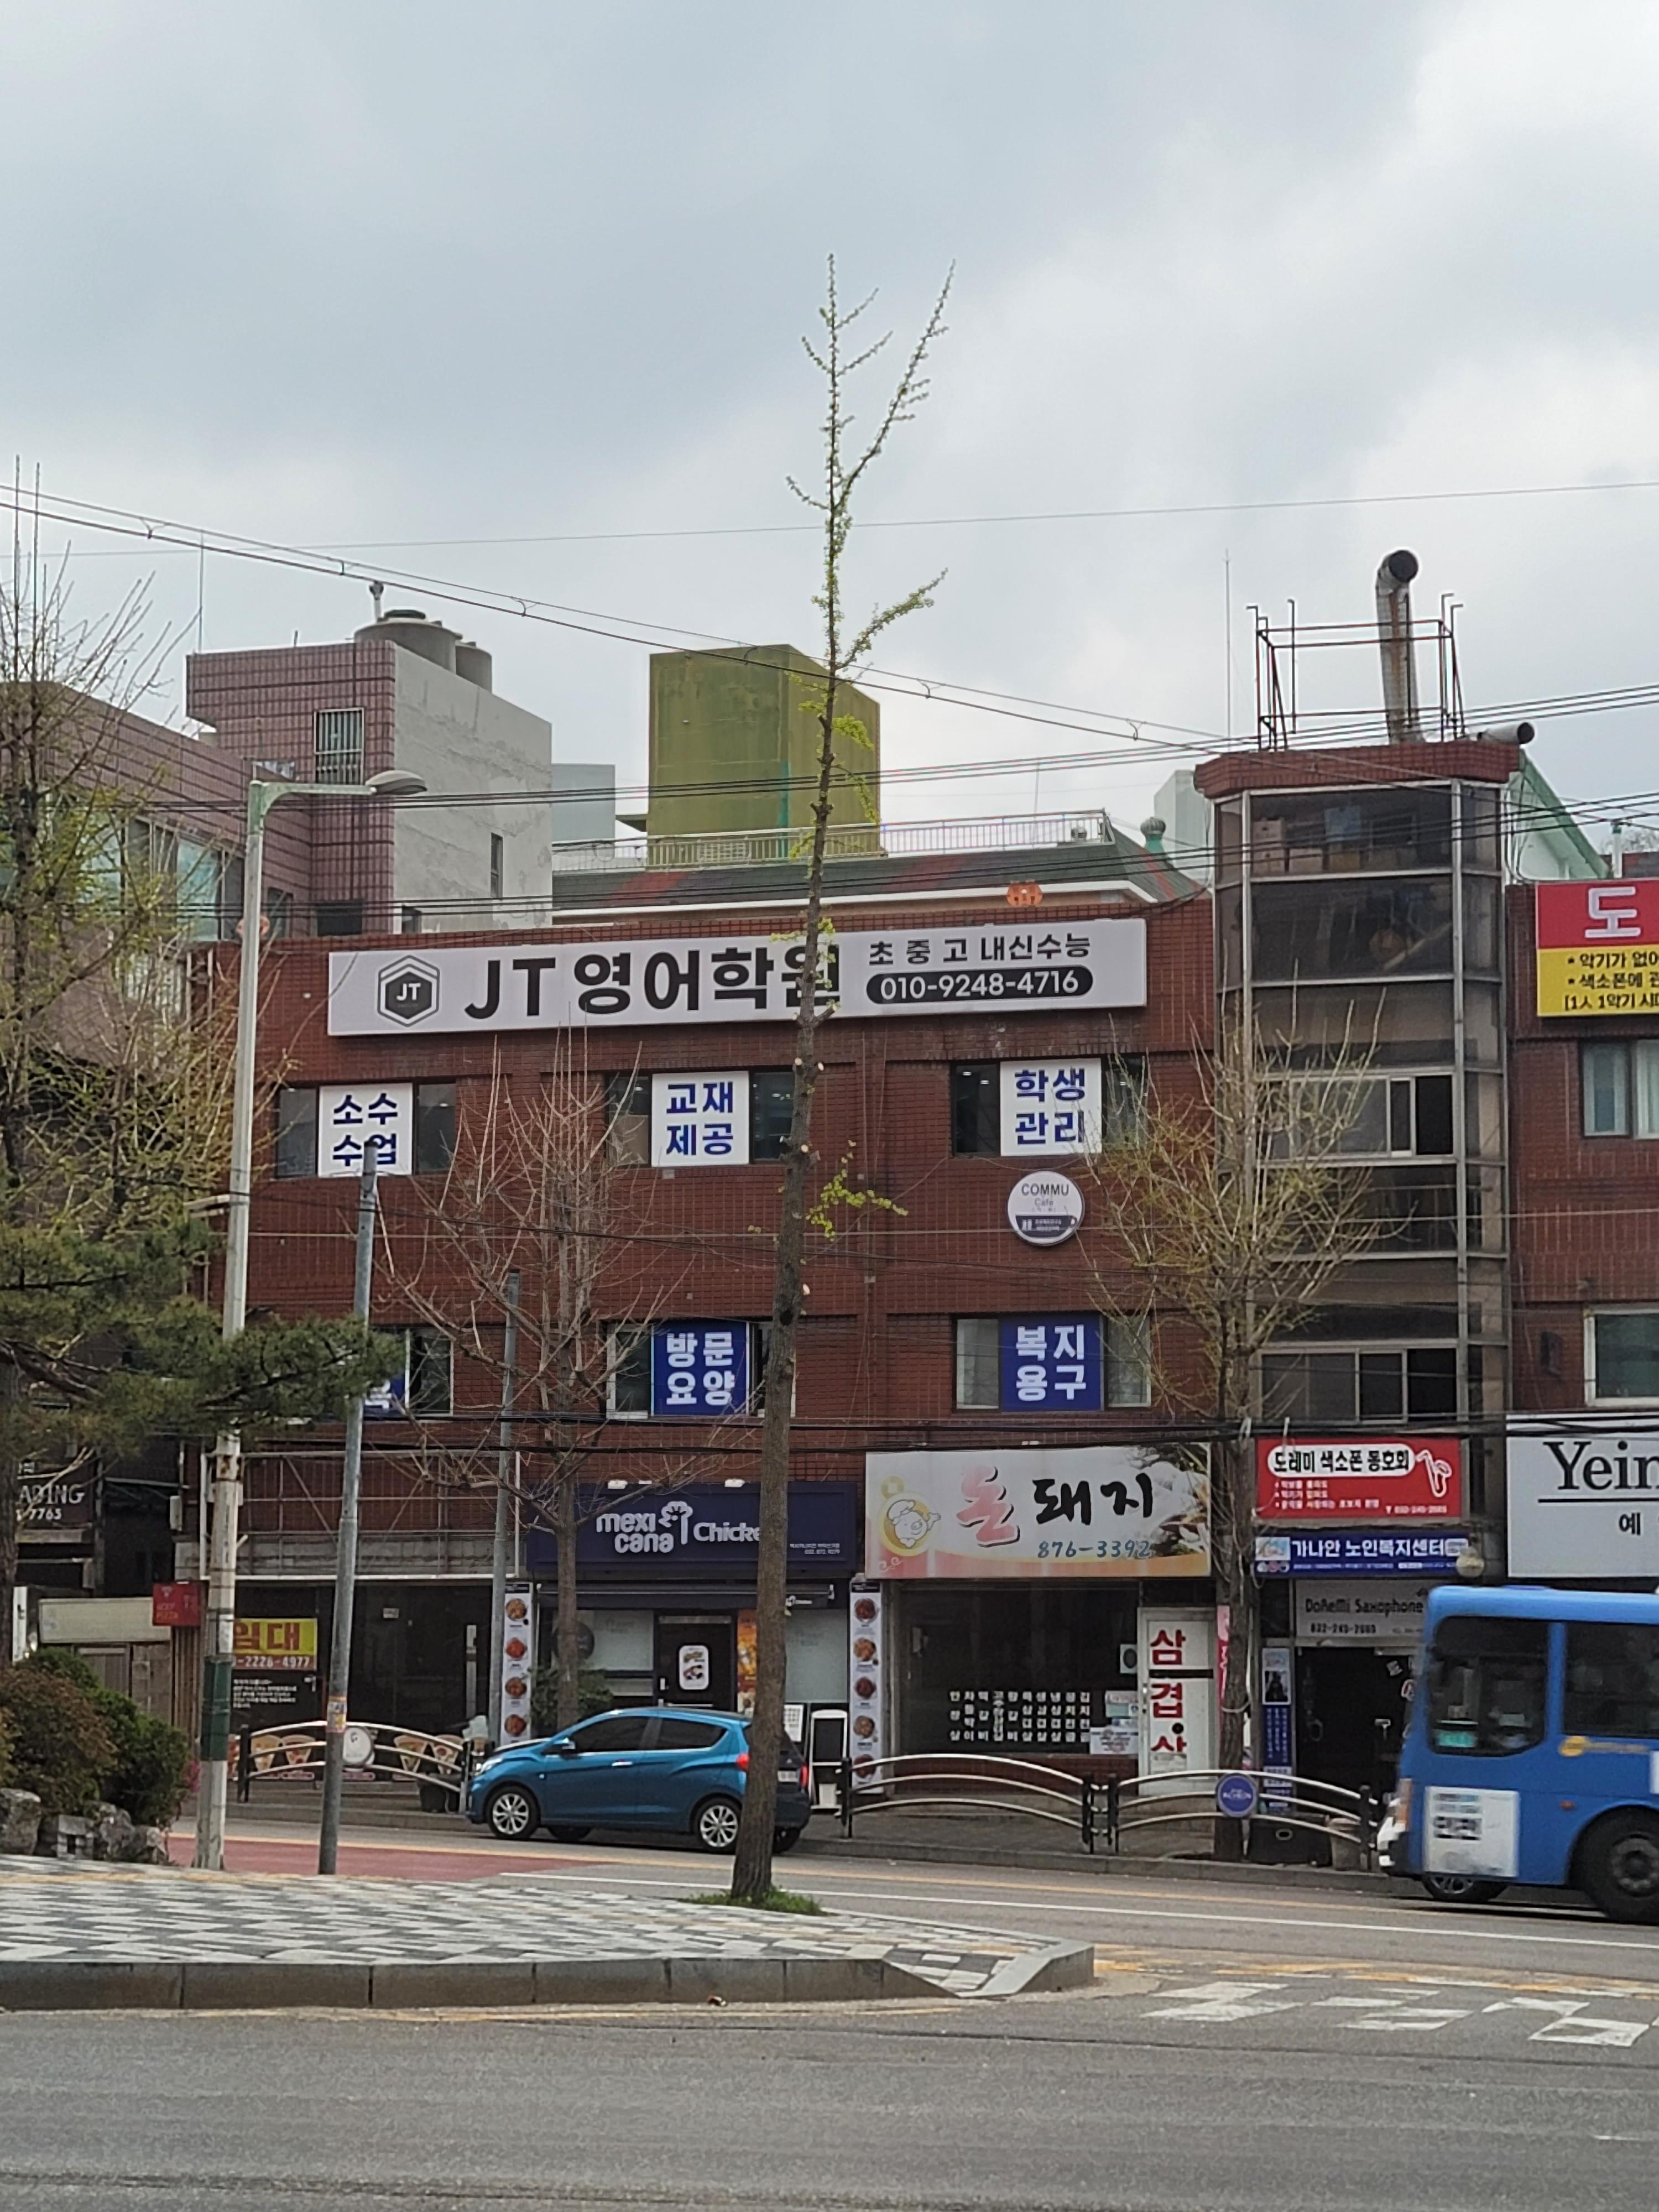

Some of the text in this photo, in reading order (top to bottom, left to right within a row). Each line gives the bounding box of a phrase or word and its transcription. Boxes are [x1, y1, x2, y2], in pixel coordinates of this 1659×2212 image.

[1585, 886, 1641, 938] 도
[869, 933, 1090, 965] 초 중 고 내신수능
[1580, 952, 1626, 968] 악기가
[396, 983, 421, 1001] JT
[880, 970, 1078, 1000] 010-9248-4716
[1639, 993, 1659, 1007] 시
[666, 1081, 733, 1114] 교재
[1014, 1068, 1085, 1102] 학생
[333, 1093, 398, 1125] 소수
[666, 1123, 733, 1155] 제공
[1015, 1110, 1084, 1145] 관리
[333, 1133, 397, 1167] 수업
[1021, 1183, 1070, 1196] COMMU
[666, 1332, 734, 1368] 방문
[1015, 1324, 1084, 1361] 복지
[666, 1370, 735, 1406] 요양
[1015, 1364, 1087, 1401] 용구
[1274, 1451, 1314, 1473] 도레미
[1368, 1449, 1409, 1472] 동호회
[16, 1484, 85, 1505] ADING
[596, 1513, 656, 1532] mexi
[693, 1522, 761, 1542] Chicke
[1619, 1512, 1641, 1535] 예
[614, 1532, 674, 1553] cana
[1037, 1540, 1150, 1559] 876-3392
[1292, 1540, 1340, 1557] 가나안
[1345, 1538, 1444, 1557] 노인복지센터
[1355, 1598, 1423, 1616] Saxophone
[233, 1623, 300, 1650] 임대
